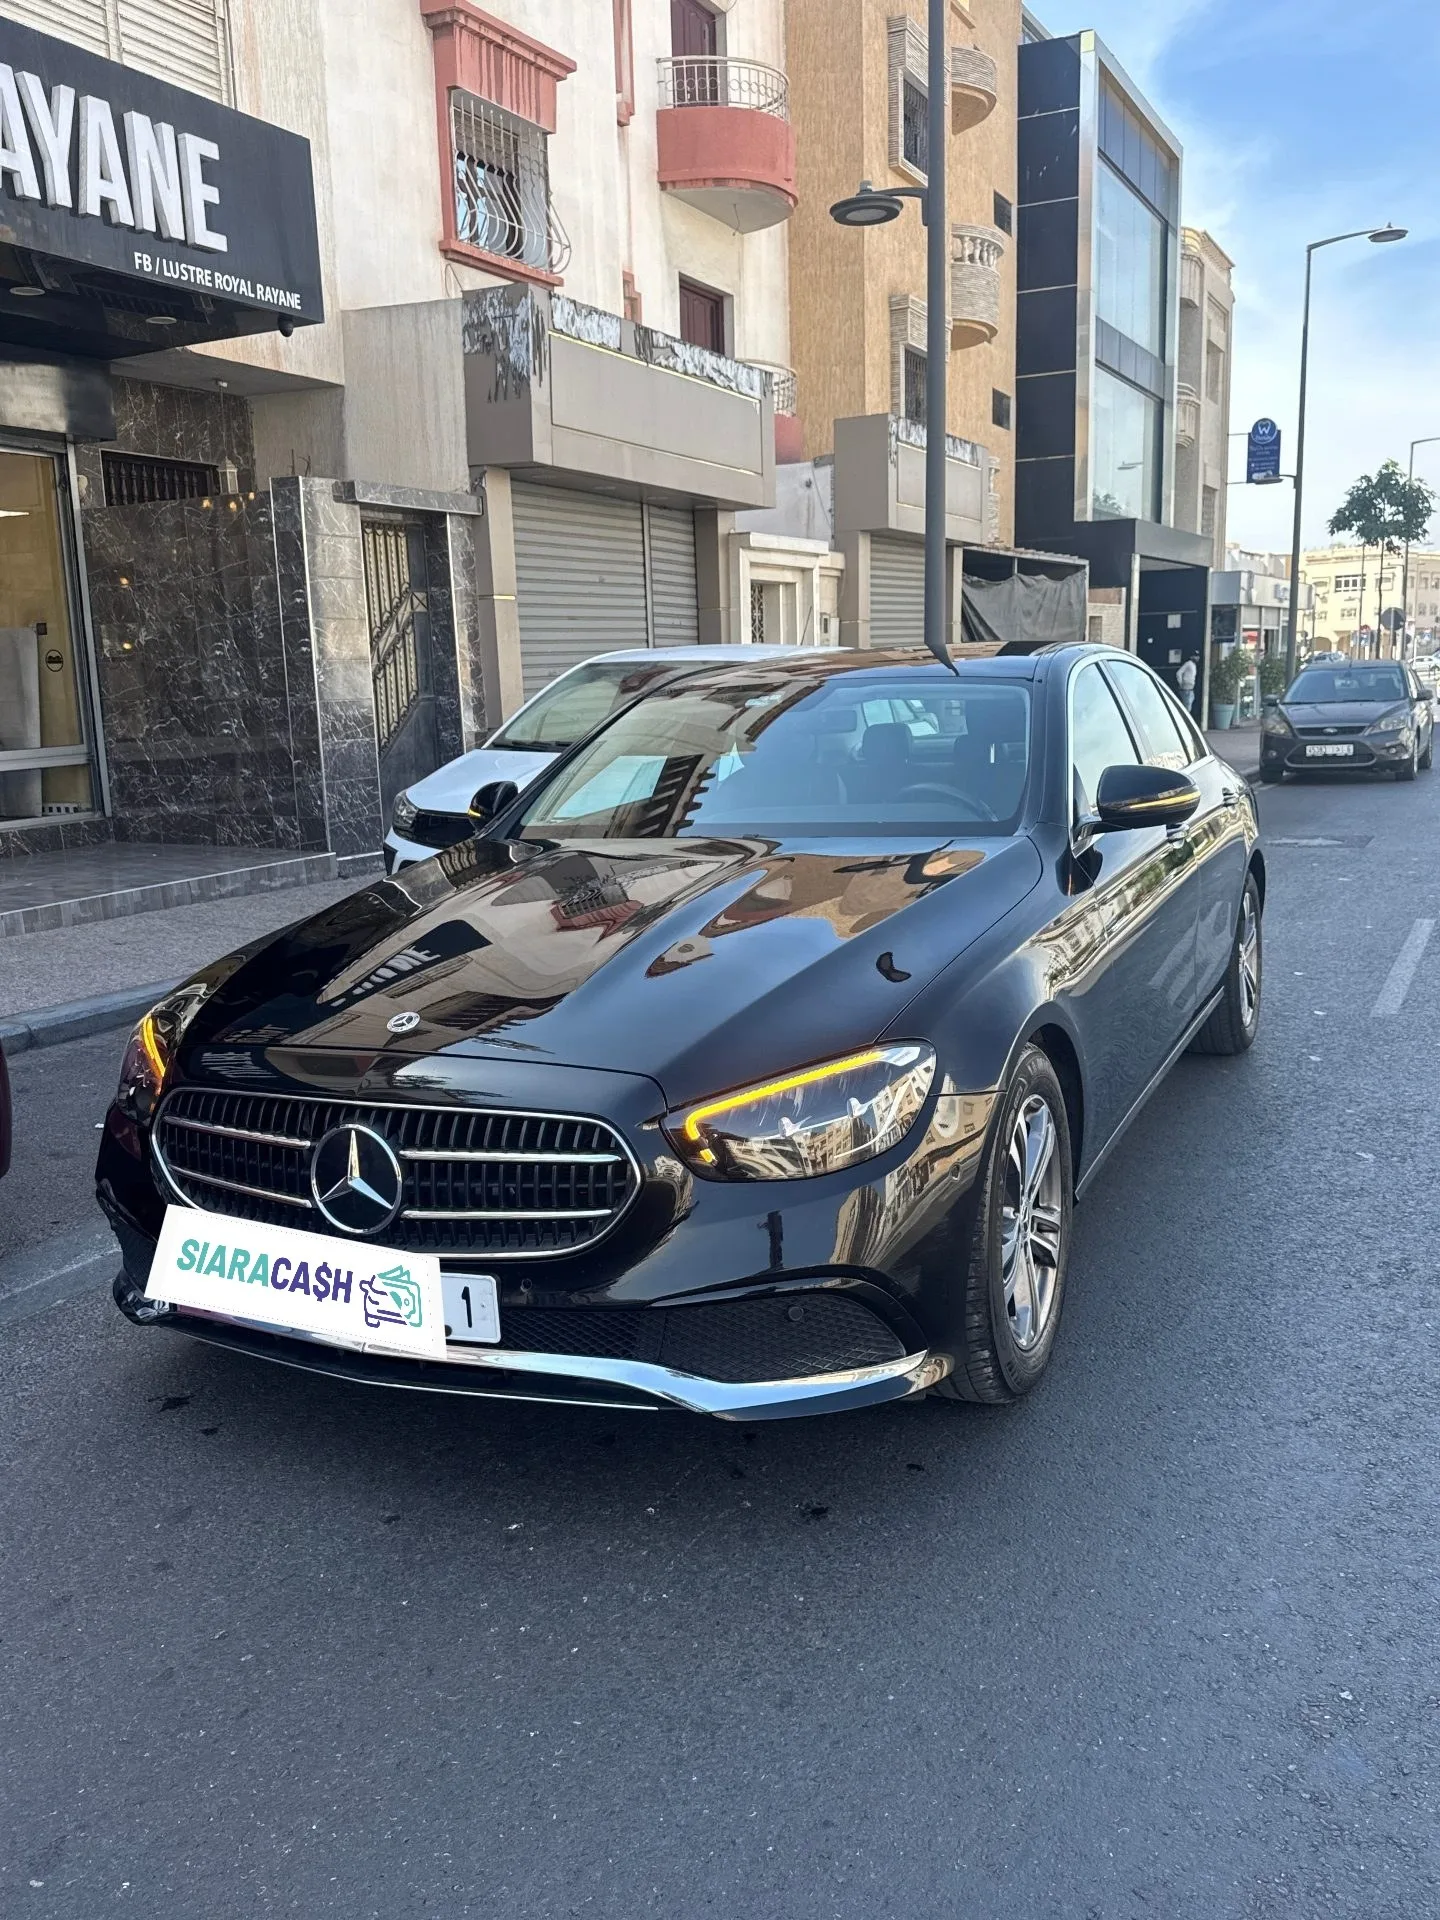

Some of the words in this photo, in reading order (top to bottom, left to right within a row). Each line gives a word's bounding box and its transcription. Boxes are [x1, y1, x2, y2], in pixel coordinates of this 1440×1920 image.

[134, 251, 152, 272] FB
[155, 257, 160, 275] /
[162, 258, 213, 287] LUSTRE
[214, 271, 255, 298] ROYAL
[256, 283, 301, 310] RAYANE
[461, 1286, 473, 1329] 1
